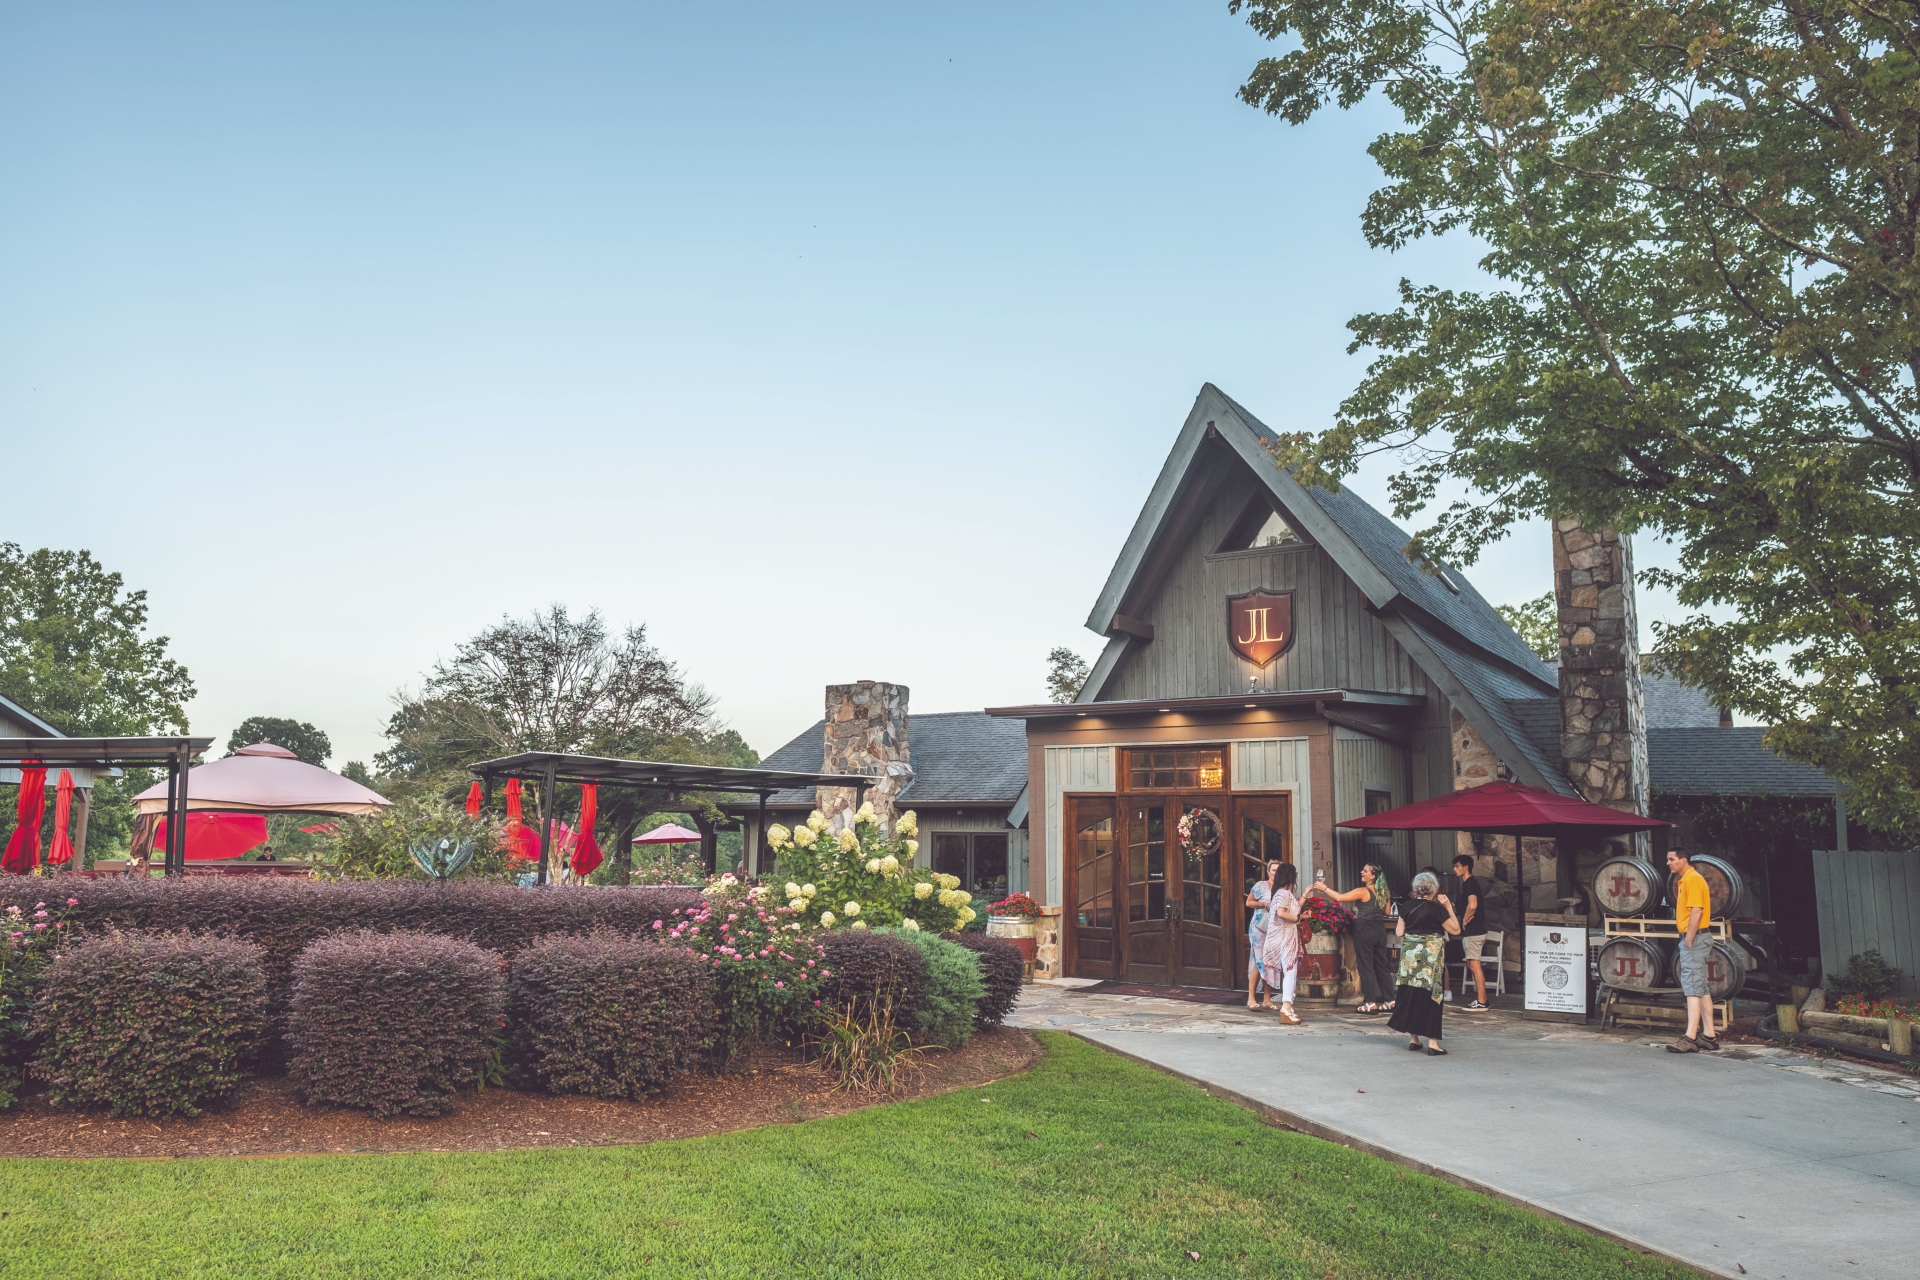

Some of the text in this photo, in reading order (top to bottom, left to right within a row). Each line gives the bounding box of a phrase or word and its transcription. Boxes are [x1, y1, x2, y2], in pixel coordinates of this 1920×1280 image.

[1238, 608, 1283, 643] JL
[1313, 841, 1332, 870] 219
[1609, 876, 1641, 898] JL
[1614, 957, 1646, 978] JL
[1706, 961, 1725, 982] L
